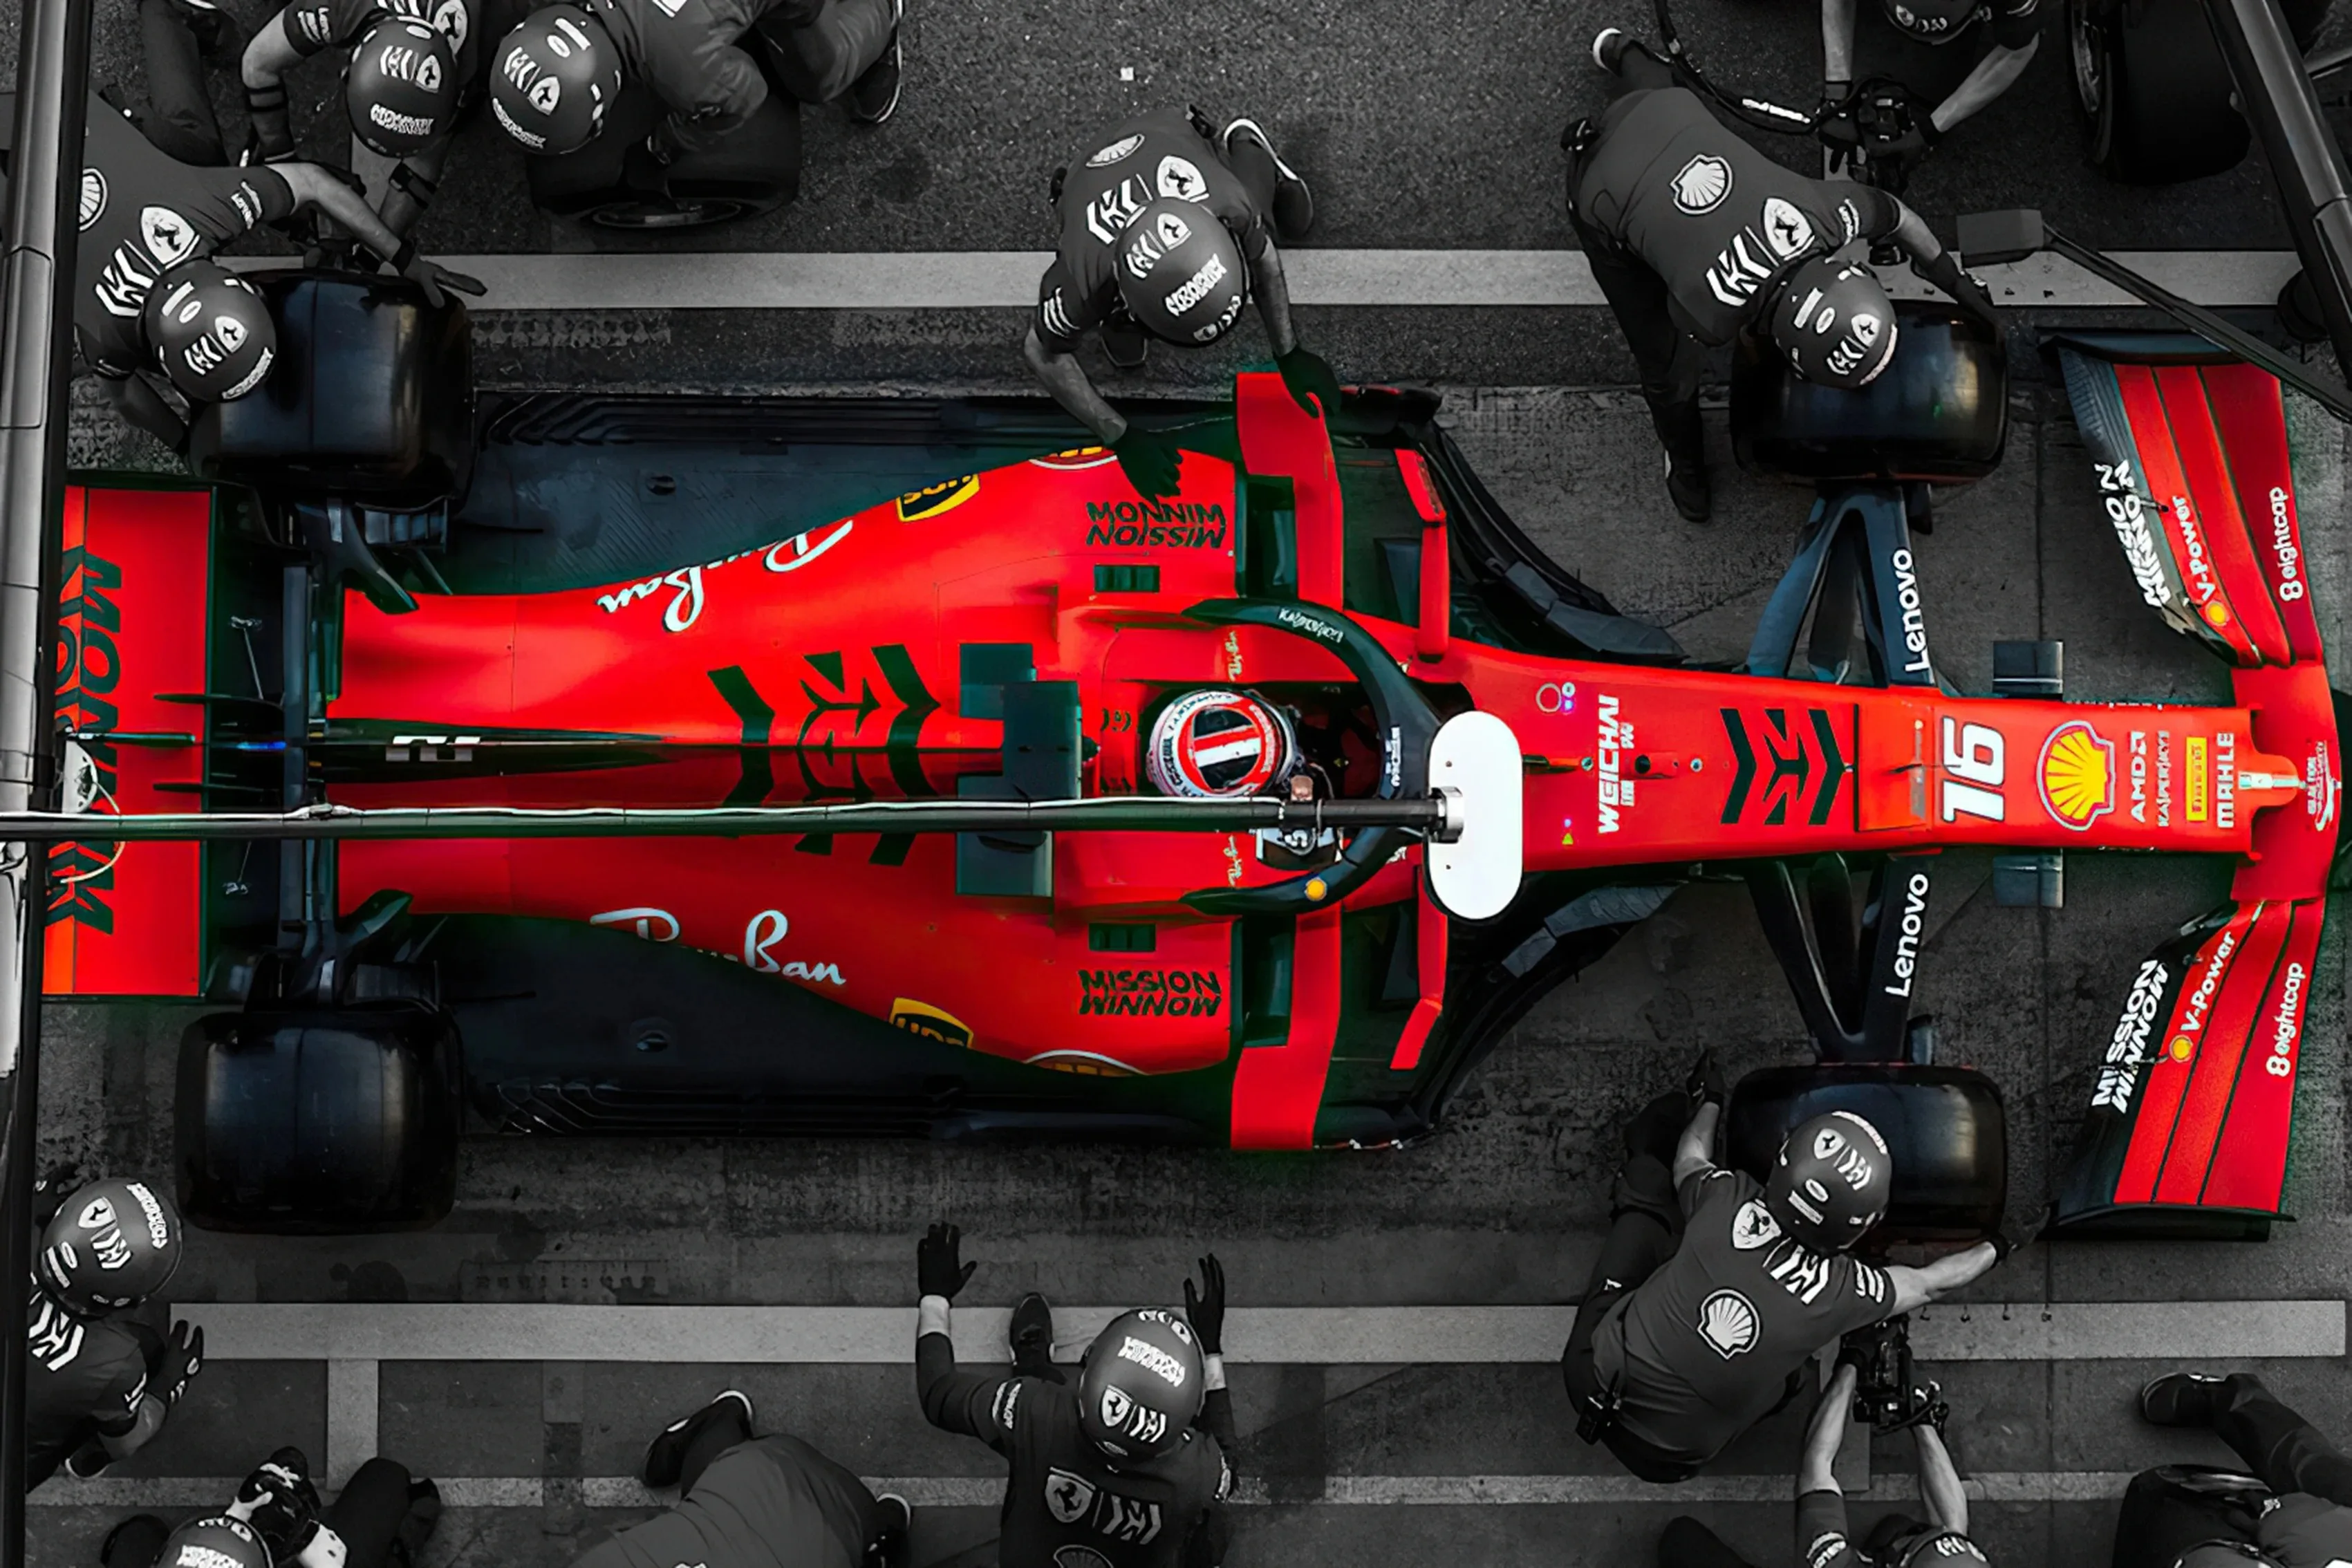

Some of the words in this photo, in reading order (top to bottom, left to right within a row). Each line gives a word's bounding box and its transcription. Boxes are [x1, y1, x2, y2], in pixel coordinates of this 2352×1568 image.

[1893, 549, 1930, 674] Lenovo
[1598, 695, 1619, 834] WEICHAI
[1943, 717, 2005, 823] 16
[2131, 756, 2146, 823] AMD
[2217, 732, 2234, 828] MAHLE
[1078, 970, 1221, 996] MISSION
[1885, 873, 1930, 998] Lenovo
[2181, 932, 2236, 1031] V-Power
[1079, 995, 1220, 1018] WINNOW
